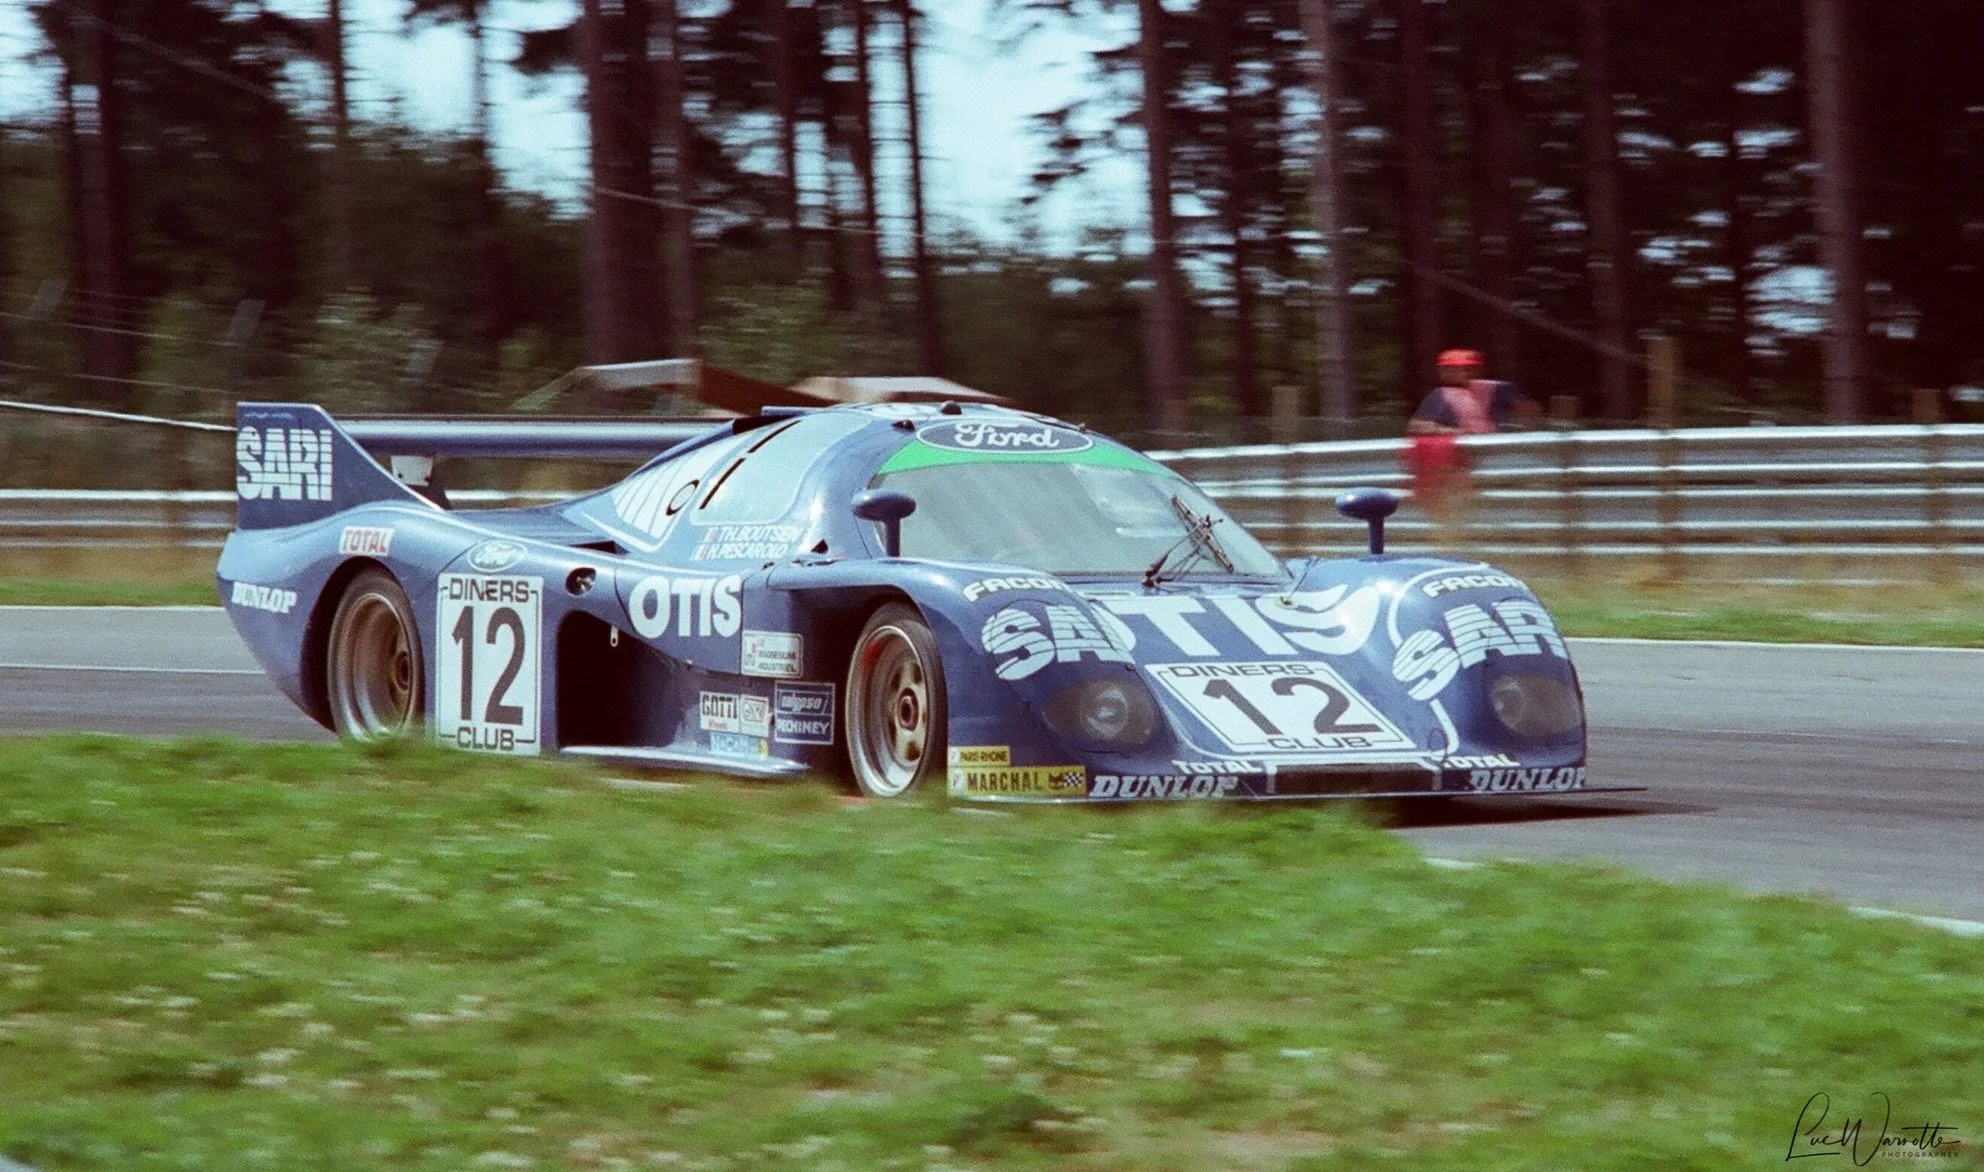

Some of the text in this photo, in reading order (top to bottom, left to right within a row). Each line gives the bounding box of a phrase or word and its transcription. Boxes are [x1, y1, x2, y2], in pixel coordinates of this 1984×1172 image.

[954, 422, 1060, 447] Ford
[236, 426, 333, 501] SARI
[342, 529, 388, 553] TOTAL
[232, 582, 298, 613] DUNLOP
[450, 577, 530, 603] DINERS
[628, 575, 742, 638] OTIS
[452, 606, 525, 725] 12
[1168, 665, 1315, 677] DINERS
[702, 694, 737, 719] GOTTI
[1203, 677, 1384, 735] 12
[457, 726, 515, 749] CLUB
[1266, 737, 1370, 749] CLUB
[1172, 760, 1264, 775] TOTAL
[967, 770, 1042, 792] MARCHAL
[1090, 776, 1238, 798] DUNLOP
